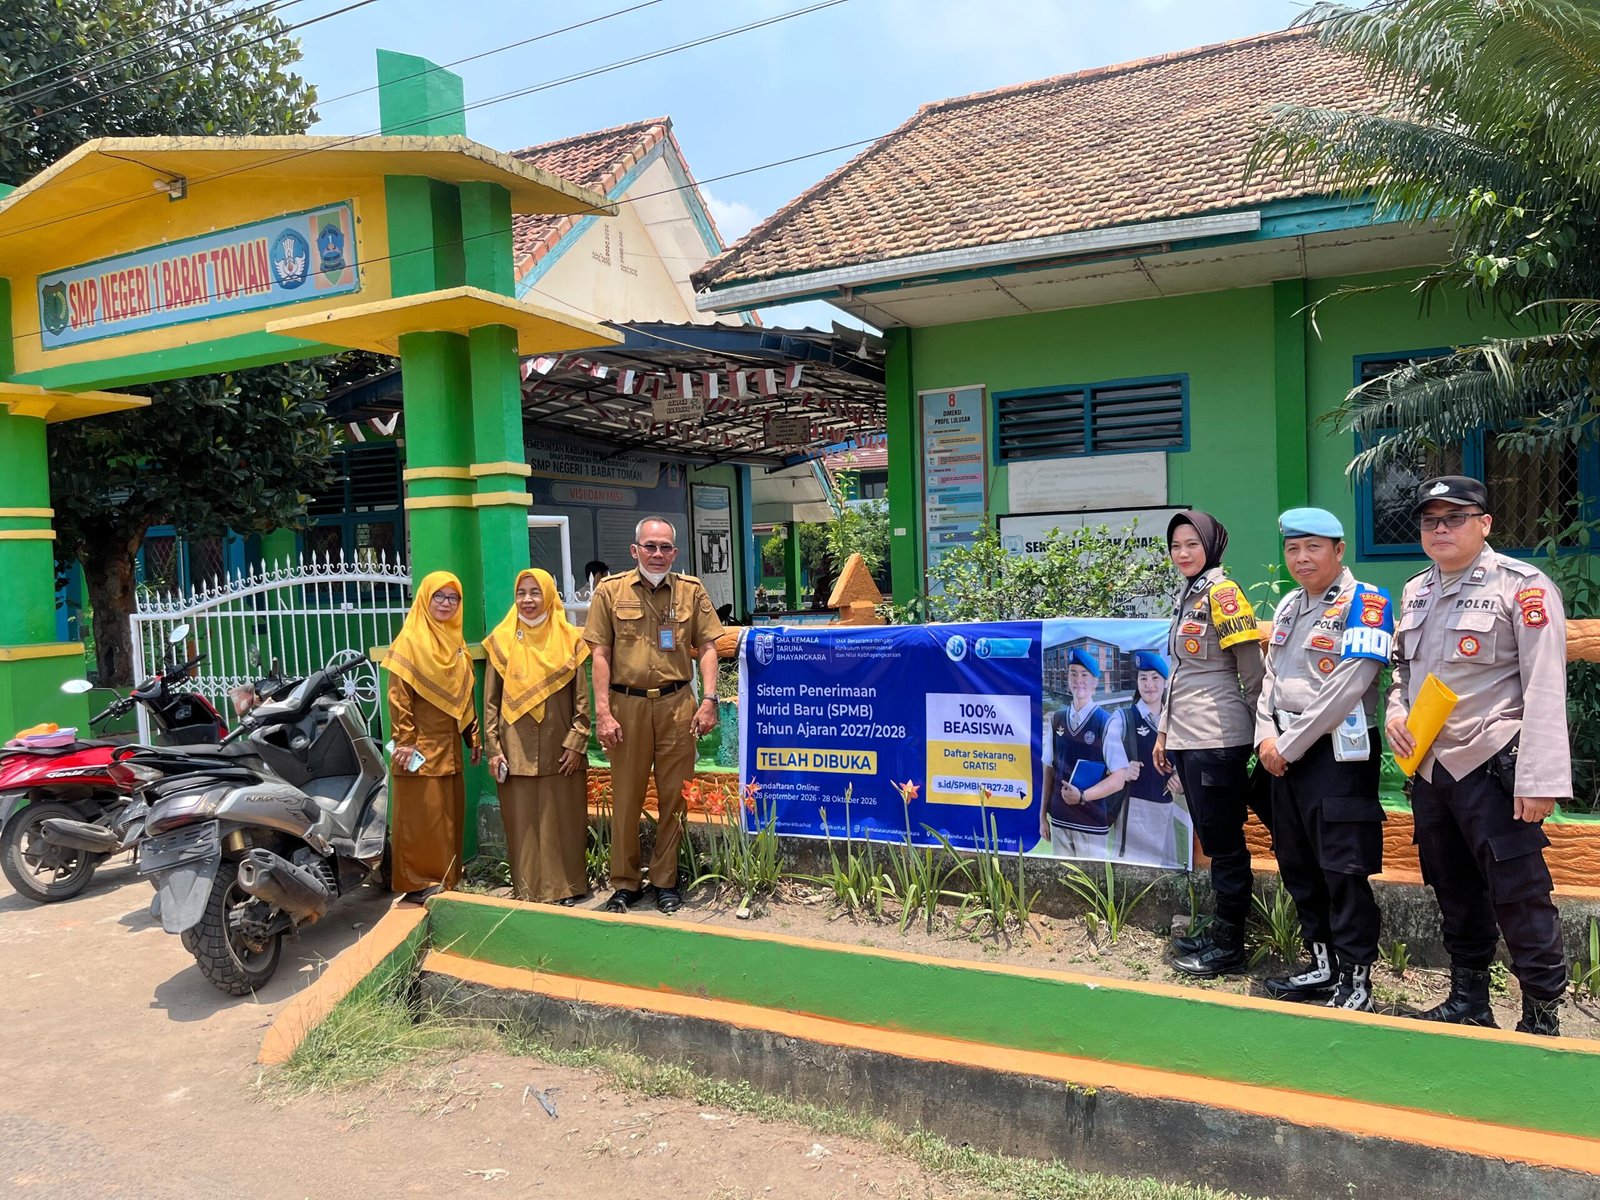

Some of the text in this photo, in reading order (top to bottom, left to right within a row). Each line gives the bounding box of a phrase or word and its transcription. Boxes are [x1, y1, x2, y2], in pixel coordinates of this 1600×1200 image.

[68, 277, 99, 330] SMP
[100, 263, 153, 323] NEGERI
[152, 262, 161, 313] 1
[162, 251, 209, 311] BABAT
[210, 238, 271, 301] TOMAN
[948, 392, 957, 407] 8
[943, 409, 962, 417] DIMENSI
[934, 416, 971, 425] PROFIL LULUSAN
[531, 458, 551, 471] SMP
[553, 461, 583, 475] NEGERI
[591, 464, 616, 479] BABAT
[617, 468, 643, 481] TOMAN
[569, 487, 624, 502] VISI DAN MISI
[1406, 599, 1427, 609] ROBI
[1455, 599, 1496, 610] POLRI
[1312, 619, 1344, 631] POLRI
[776, 636, 820, 644] SMA KEMALA
[776, 653, 827, 661] BHAYANGKARA
[756, 683, 877, 698] Sistem Penerimaan
[756, 702, 874, 720] Murid Baru (SPMB)
[959, 703, 997, 719] 100%
[756, 721, 907, 739] Tahun Ajaran 2027/2028
[943, 721, 1015, 737] BEASISWA
[760, 752, 872, 770] TELAH DIBUKA
[943, 748, 1017, 762] Daftar Sekarang,
[962, 761, 997, 771] GRATIS!
[795, 782, 821, 792] Online:
[763, 793, 799, 802] September
[800, 793, 817, 802] 2026
[822, 794, 831, 802] 28
[860, 796, 878, 806] 2026
